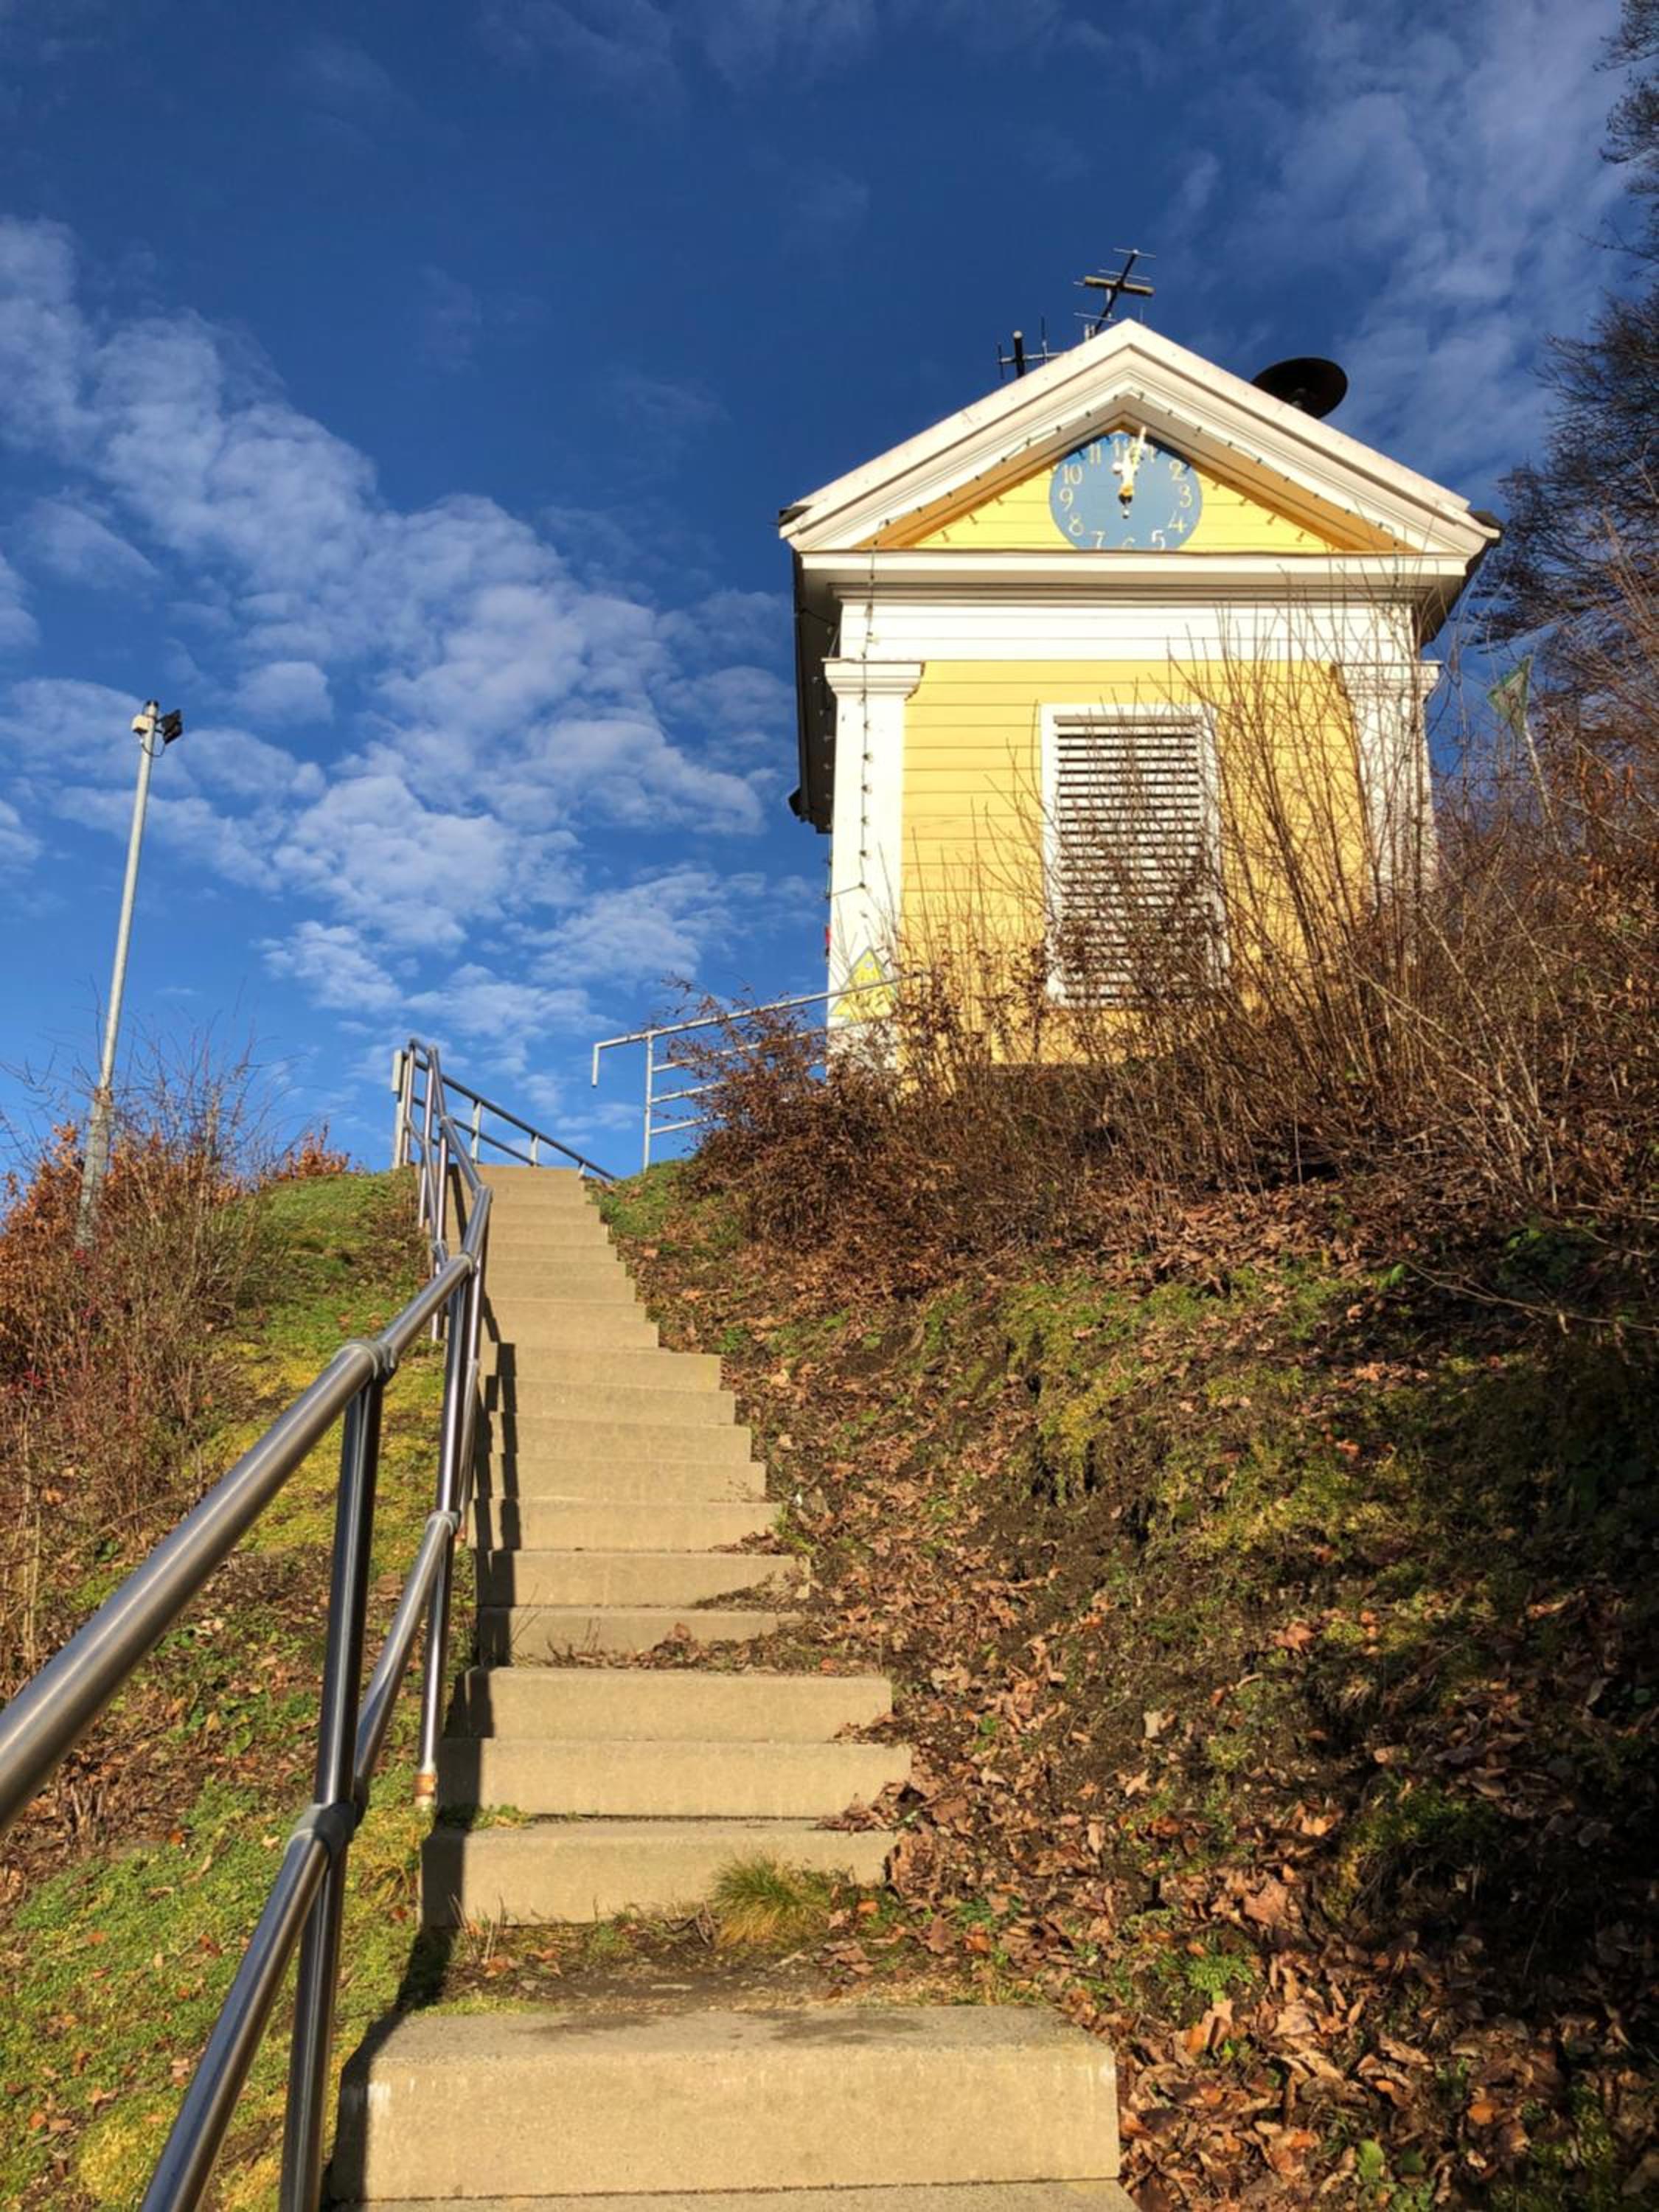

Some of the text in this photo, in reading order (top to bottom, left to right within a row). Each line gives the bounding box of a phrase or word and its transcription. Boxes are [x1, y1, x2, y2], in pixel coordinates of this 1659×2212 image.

[1062, 465, 1083, 484] 10
[1169, 459, 1187, 481] 2
[1060, 487, 1074, 512] 9
[1180, 484, 1192, 508] 3
[1068, 513, 1084, 537] 8
[1168, 509, 1189, 534] 4
[1090, 530, 1106, 549] 7
[1151, 529, 1166, 549] 5
